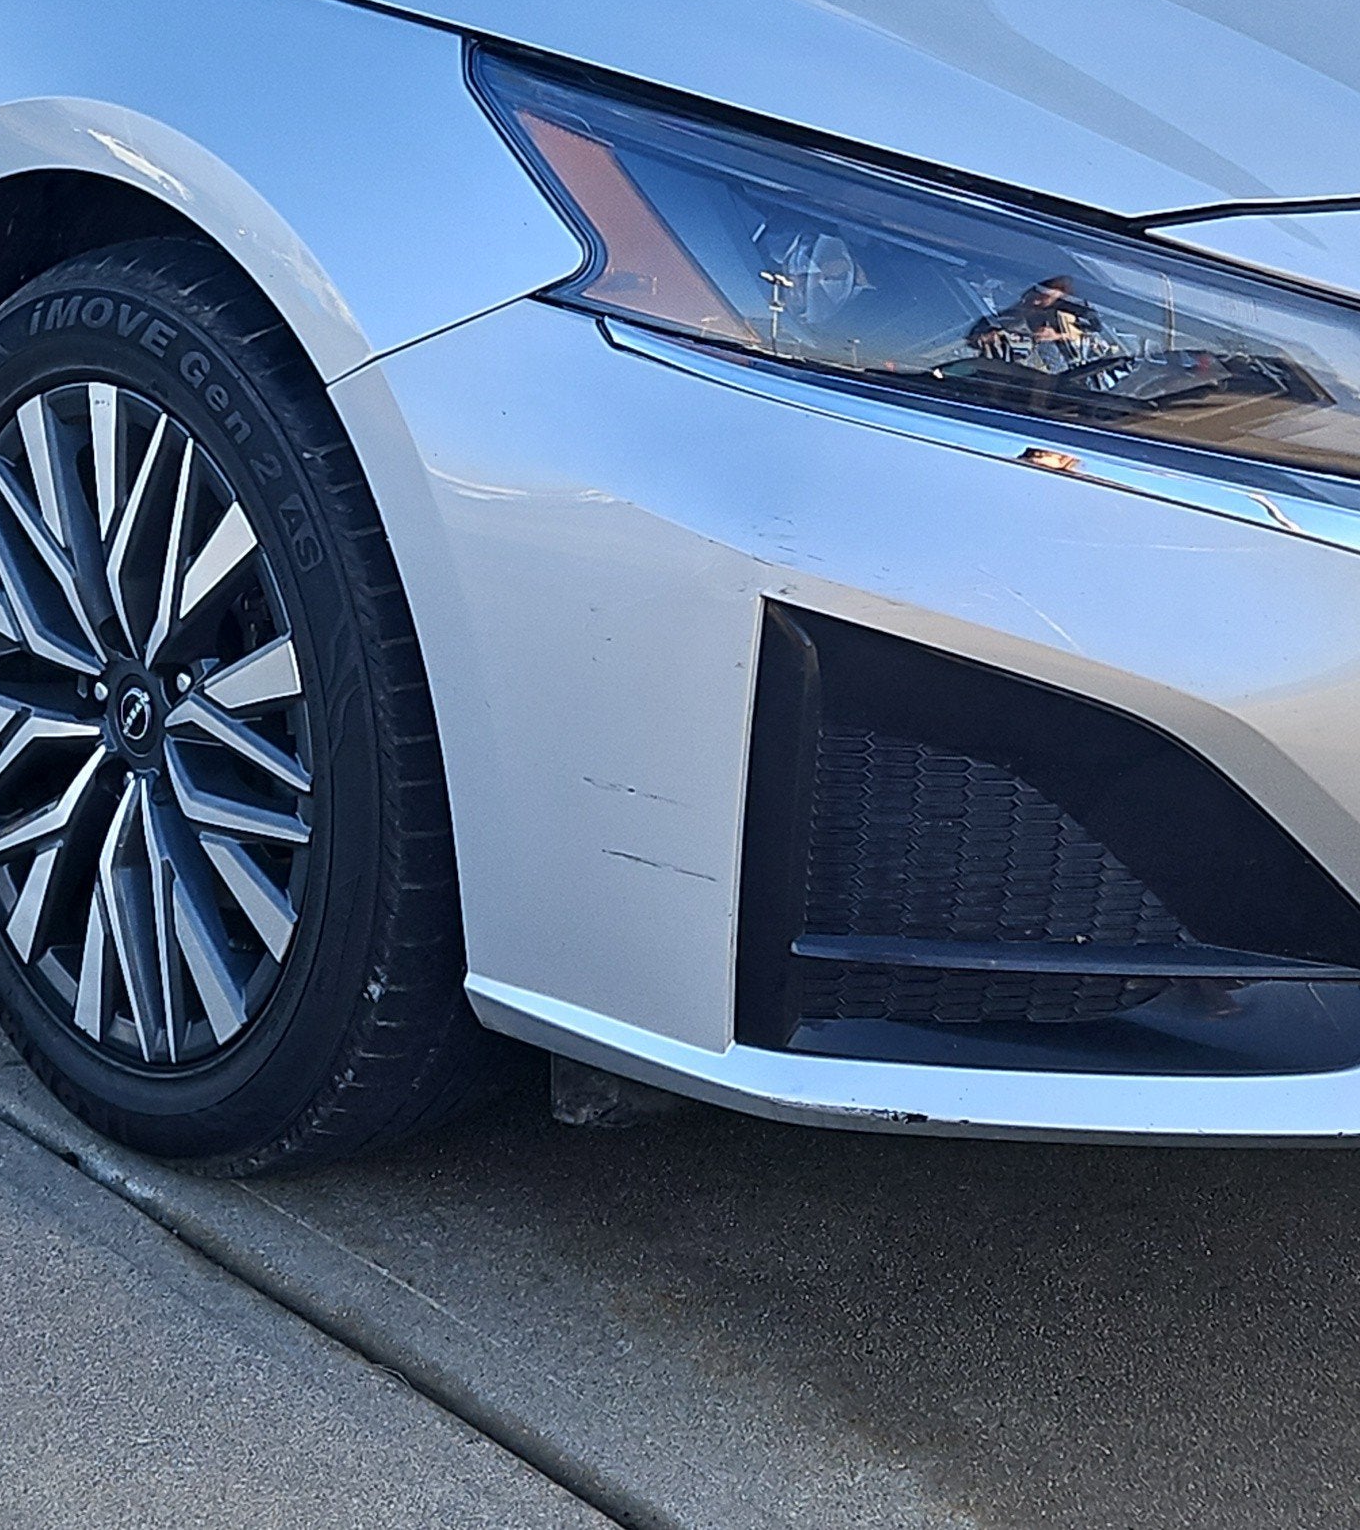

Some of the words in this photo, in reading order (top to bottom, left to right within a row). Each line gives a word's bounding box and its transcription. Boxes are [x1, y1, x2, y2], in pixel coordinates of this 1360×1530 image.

[29, 295, 178, 358] iMOVE
[179, 350, 253, 445] Gen
[249, 452, 283, 487] 2
[278, 492, 324, 573] AS
